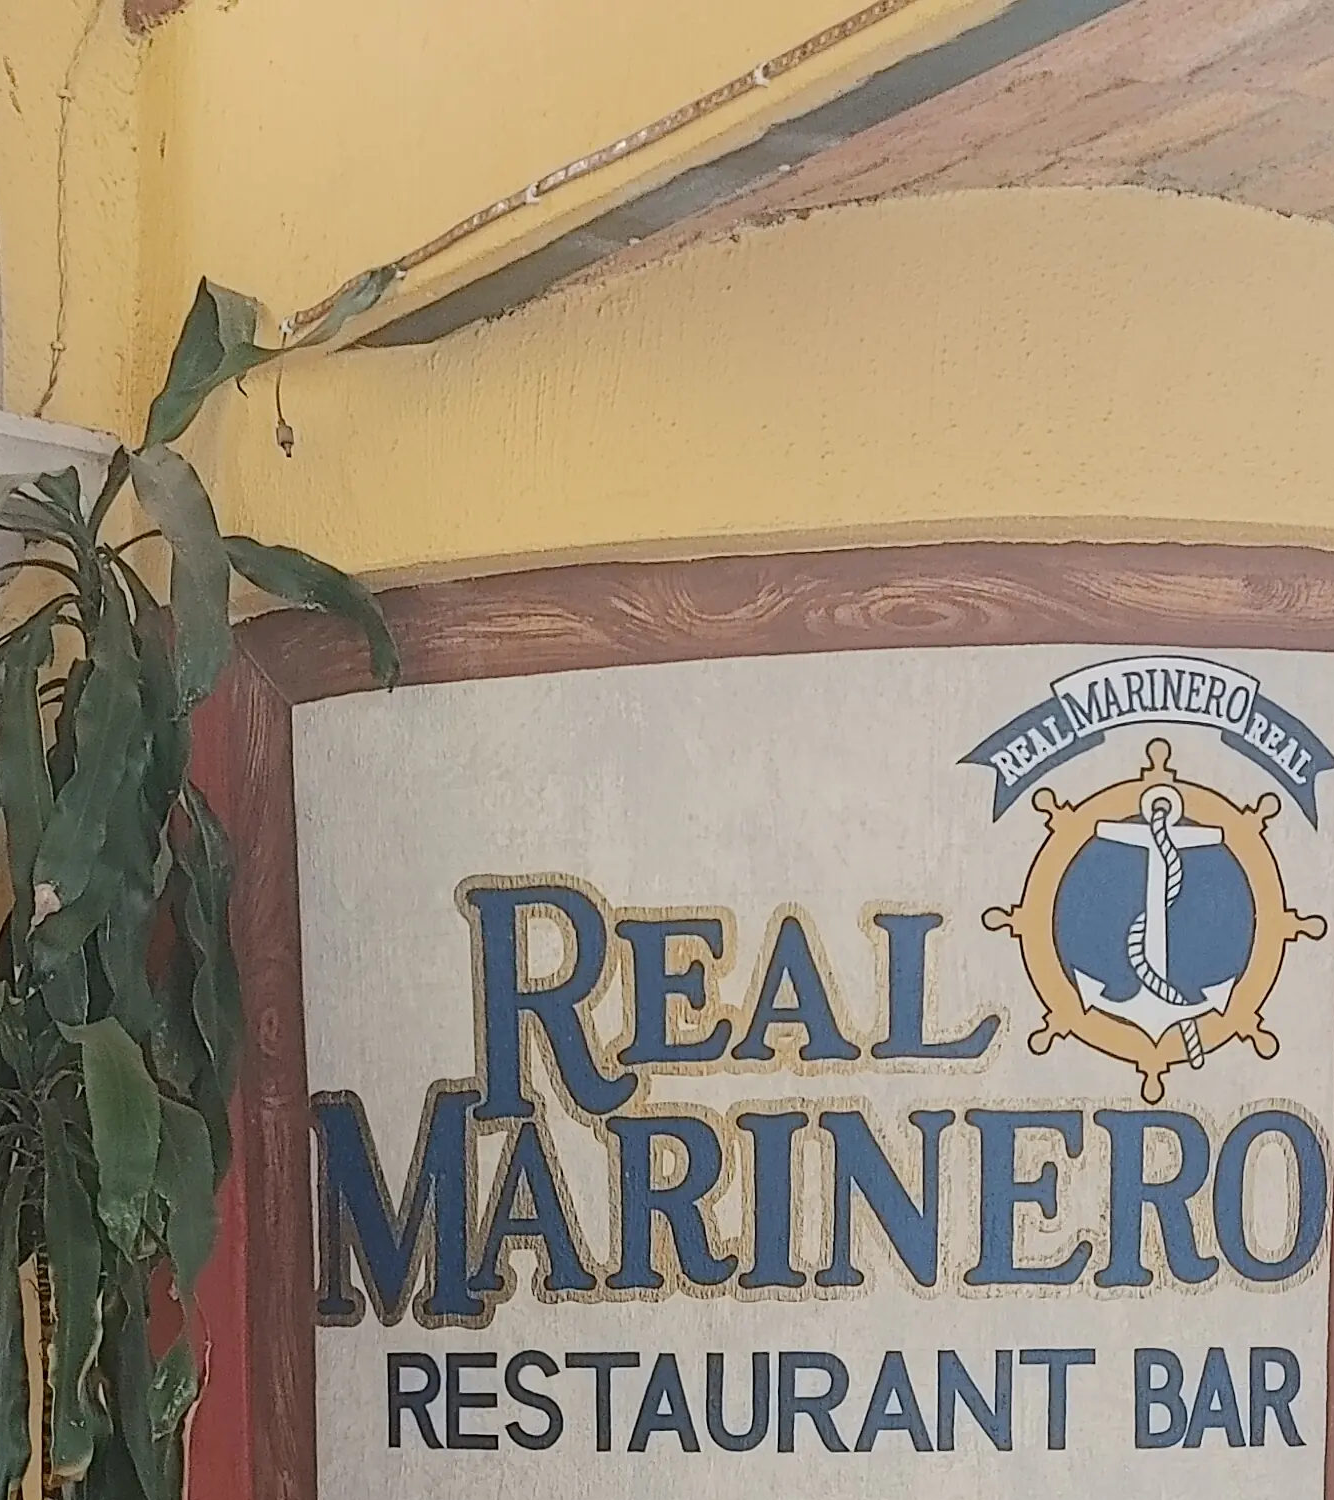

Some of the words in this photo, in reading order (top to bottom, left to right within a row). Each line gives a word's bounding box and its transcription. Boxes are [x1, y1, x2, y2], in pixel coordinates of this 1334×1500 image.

[989, 714, 1075, 787] REAL
[1061, 667, 1252, 734] MARINERO
[1243, 712, 1314, 787] REAL
[463, 880, 1005, 1121] REAL
[311, 1085, 1331, 1322] MARINERO
[386, 1347, 1097, 1454] RESTAURANT
[1132, 1345, 1308, 1449] BAR
